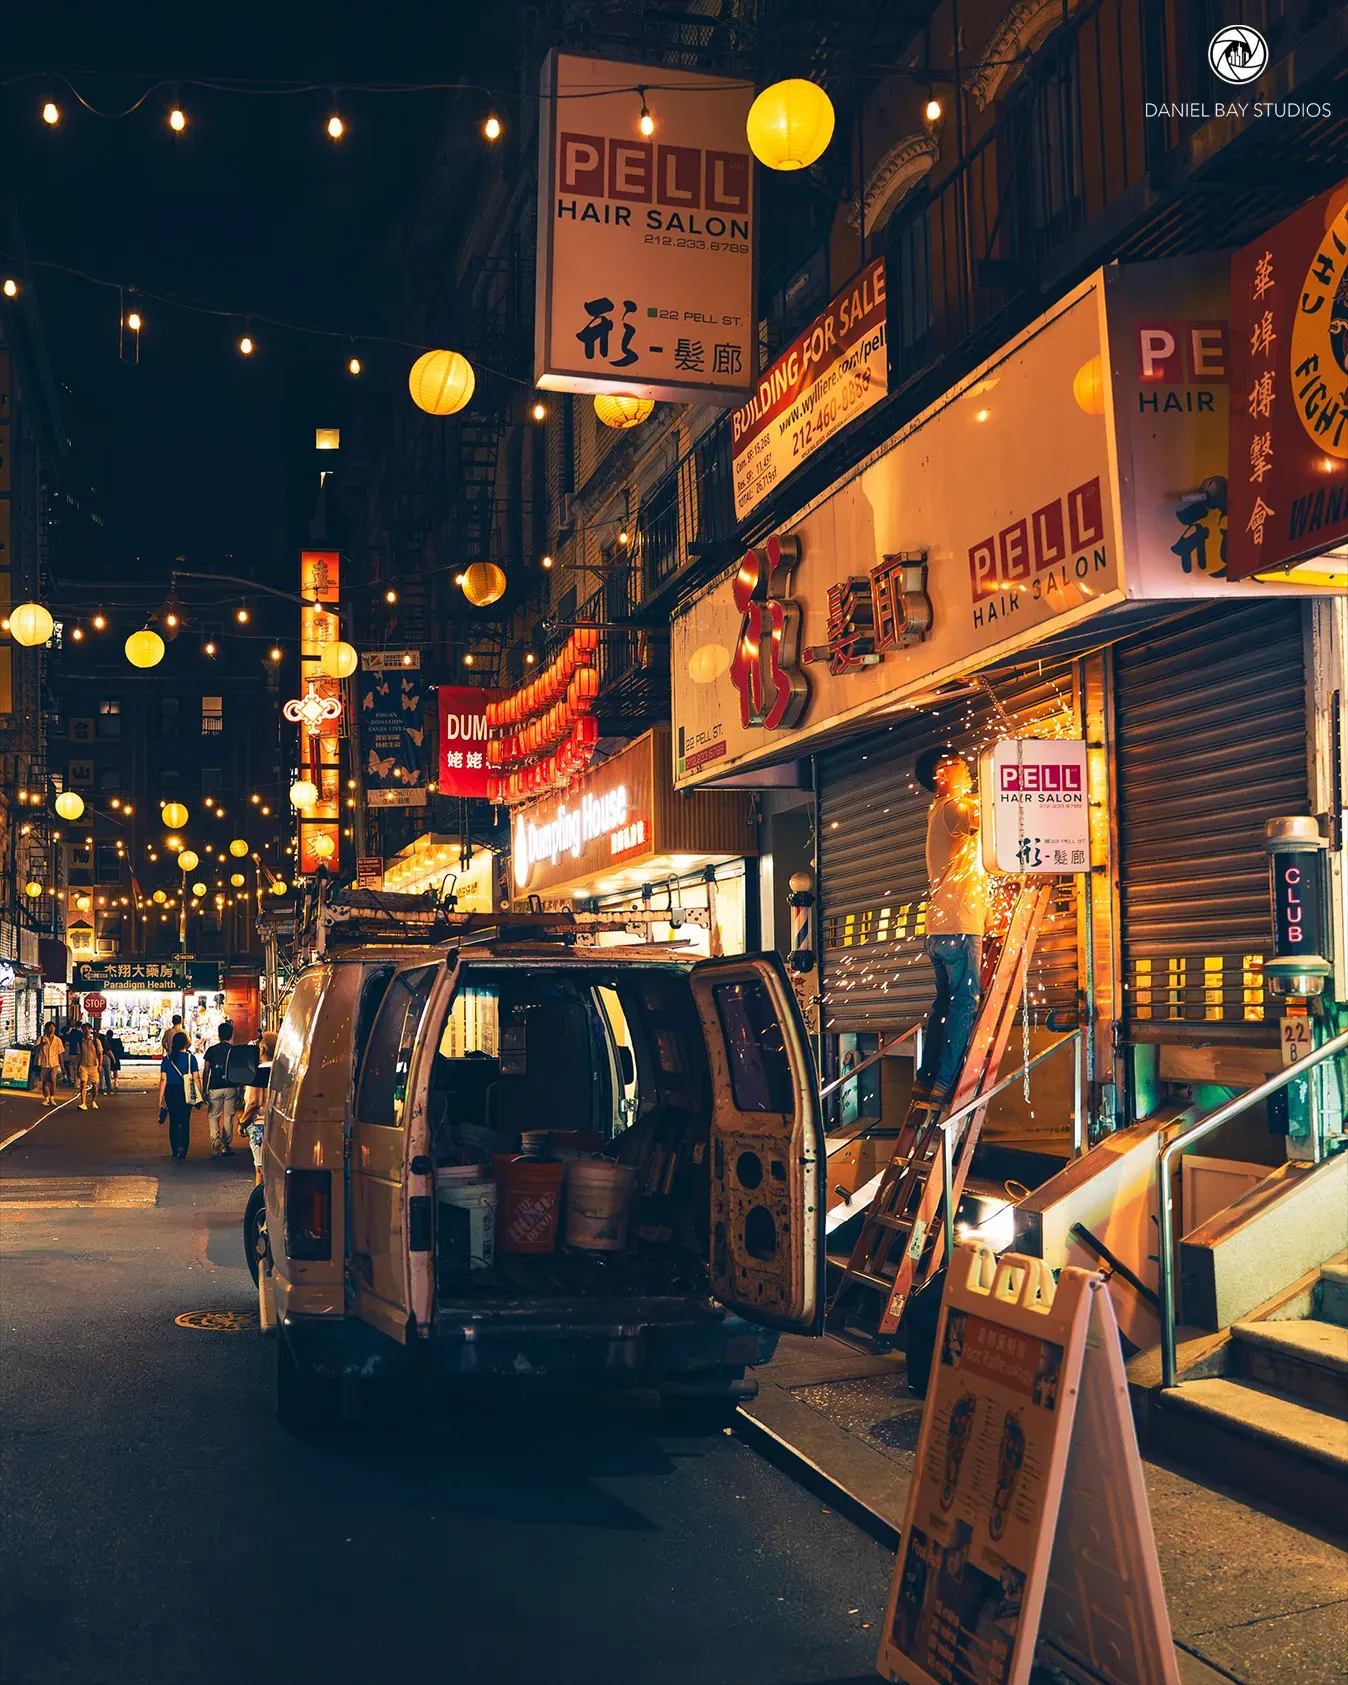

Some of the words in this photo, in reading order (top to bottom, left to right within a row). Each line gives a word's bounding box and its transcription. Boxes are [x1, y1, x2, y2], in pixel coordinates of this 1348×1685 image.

[563, 139, 742, 208] PELL
[558, 199, 631, 227] HAIR
[647, 210, 749, 240] SALON
[659, 309, 679, 321] 22
[684, 313, 718, 325] PELL
[722, 316, 744, 328] ST.
[733, 351, 798, 443] BUILDING
[802, 316, 837, 372] FOR
[839, 265, 886, 338] SALE
[1139, 391, 1215, 413] HAIR
[1289, 481, 1348, 542] WAN
[972, 492, 1097, 597] PELL
[973, 593, 1019, 629] HAIR
[1032, 546, 1106, 600] SALON
[686, 737, 695, 751] 22
[696, 731, 712, 746] PELL
[712, 723, 724, 739] ST.
[1002, 768, 1078, 788] PELL
[1038, 793, 1082, 803] SALON
[529, 802, 582, 866] Dumpling
[582, 784, 627, 842] House
[1284, 867, 1303, 943] CLUB
[104, 981, 145, 990] Paradigm
[148, 981, 176, 989] Health
[85, 999, 106, 1008] STOP
[1284, 1021, 1308, 1043] 22
[1290, 1044, 1298, 1062] B
